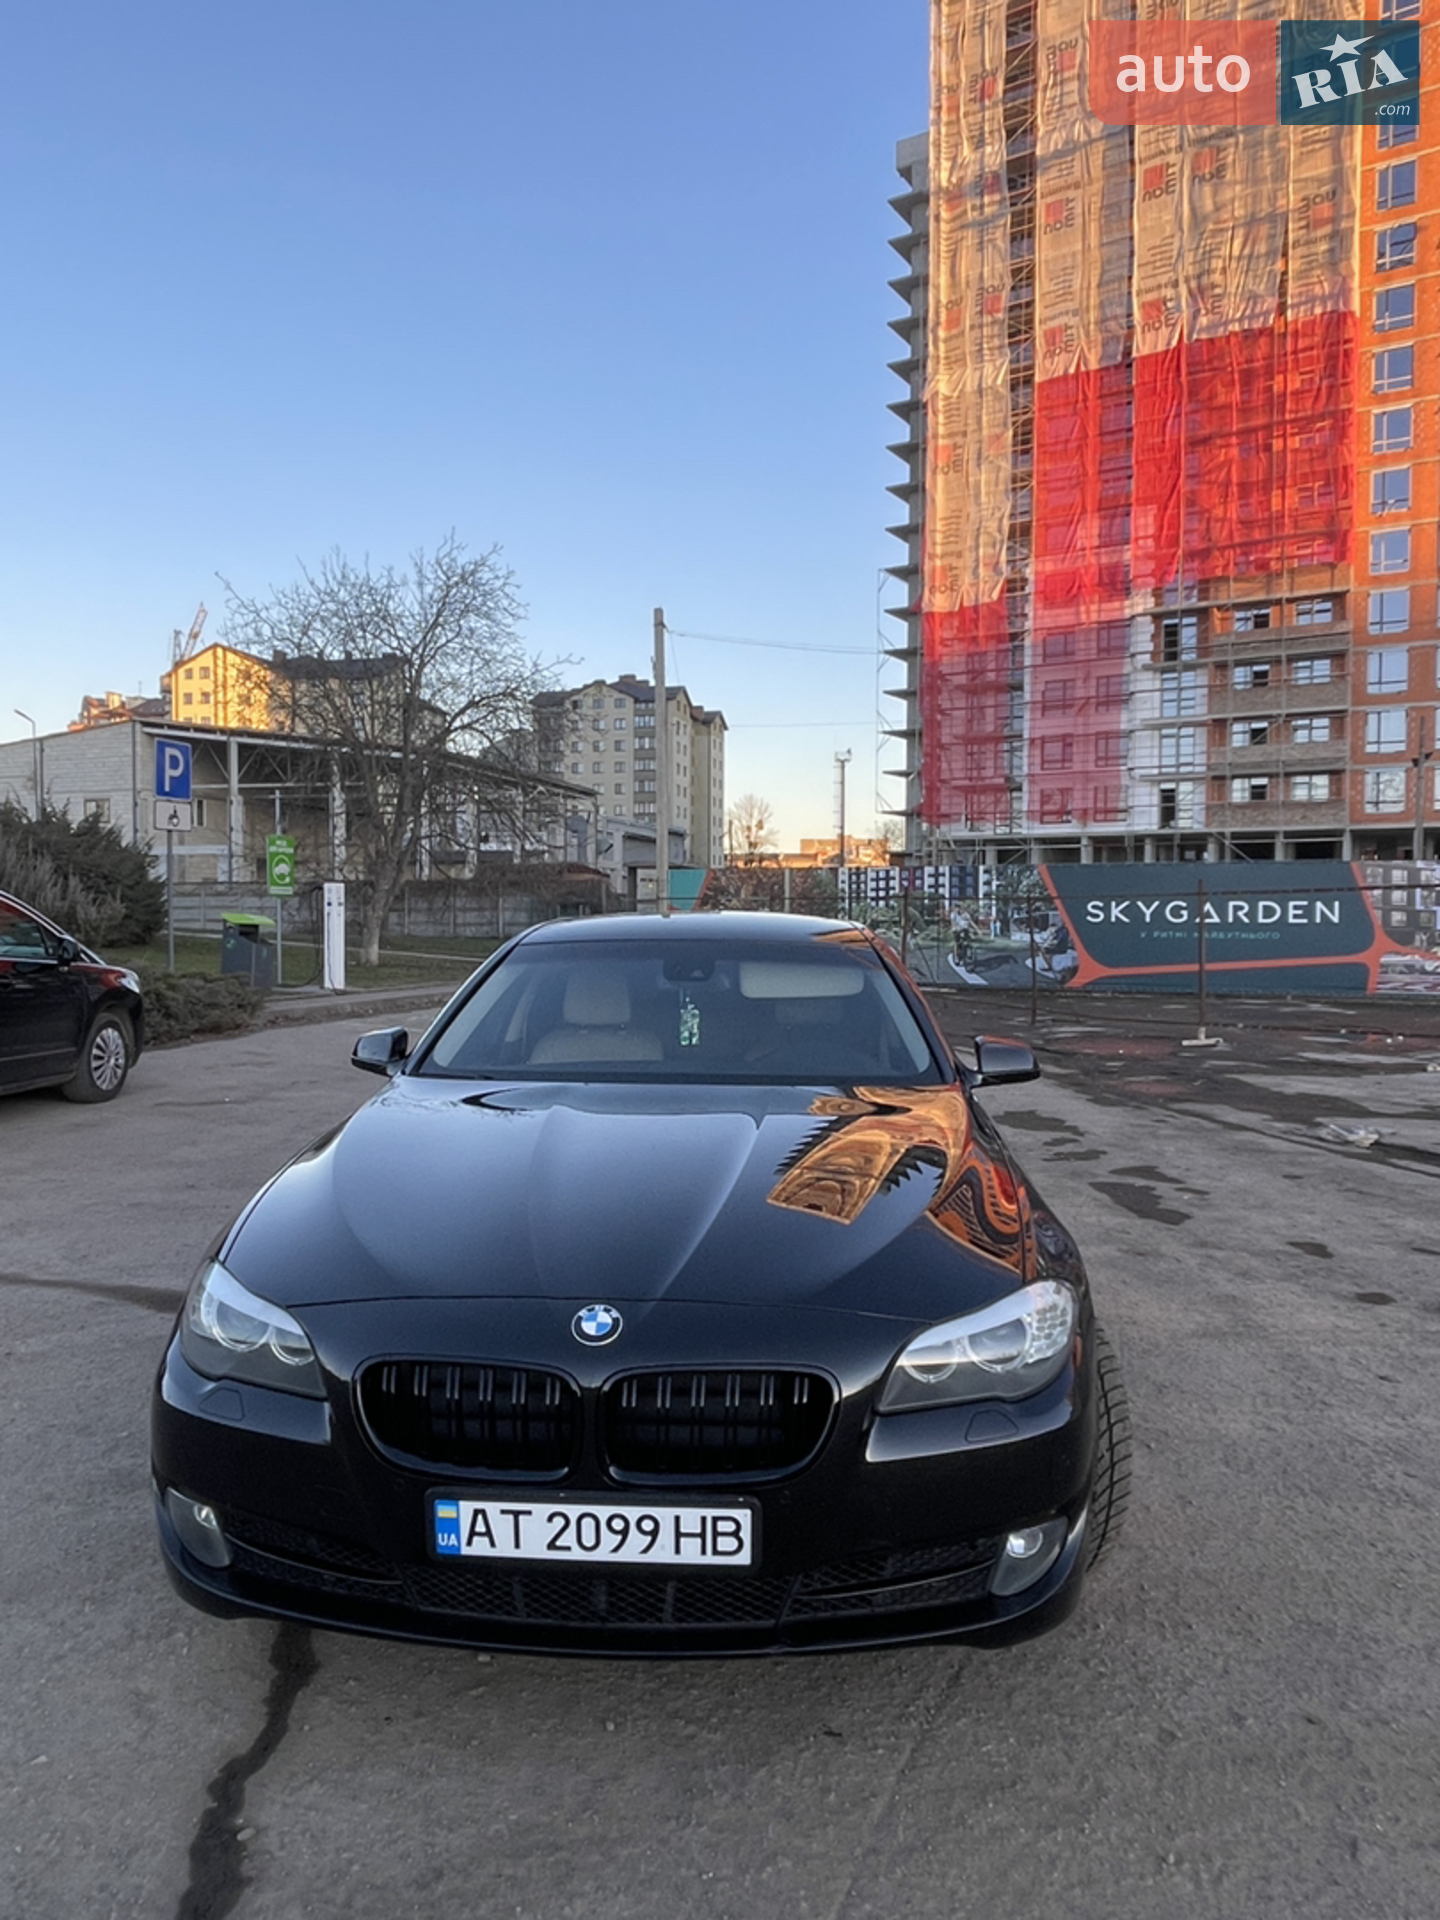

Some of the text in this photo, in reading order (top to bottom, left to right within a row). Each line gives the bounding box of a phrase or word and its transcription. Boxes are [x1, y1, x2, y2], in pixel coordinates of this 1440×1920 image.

[164, 747, 185, 792] P
[1086, 901, 1340, 923] SKYGARDEN
[438, 1533, 458, 1547] UA
[466, 1509, 744, 1557] AT 2099 HB
